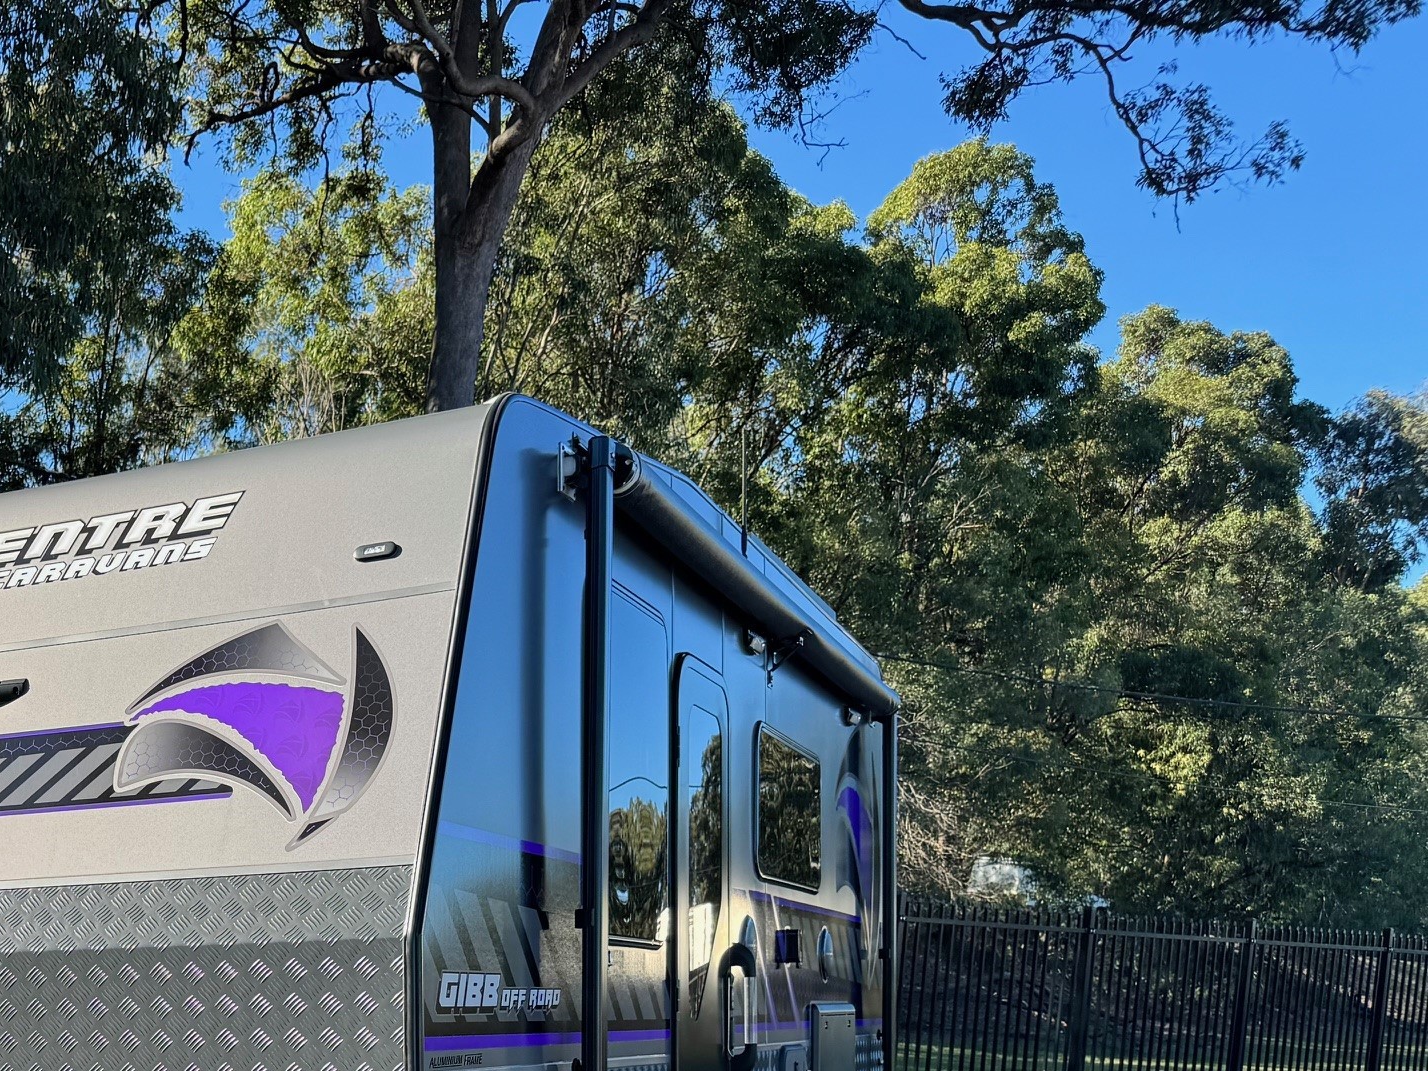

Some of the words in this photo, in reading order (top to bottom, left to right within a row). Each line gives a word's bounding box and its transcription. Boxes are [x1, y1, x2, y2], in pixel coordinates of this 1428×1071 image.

[438, 972, 502, 1011] GIBB
[501, 988, 527, 1010] OFF
[528, 988, 562, 1010] ROAD
